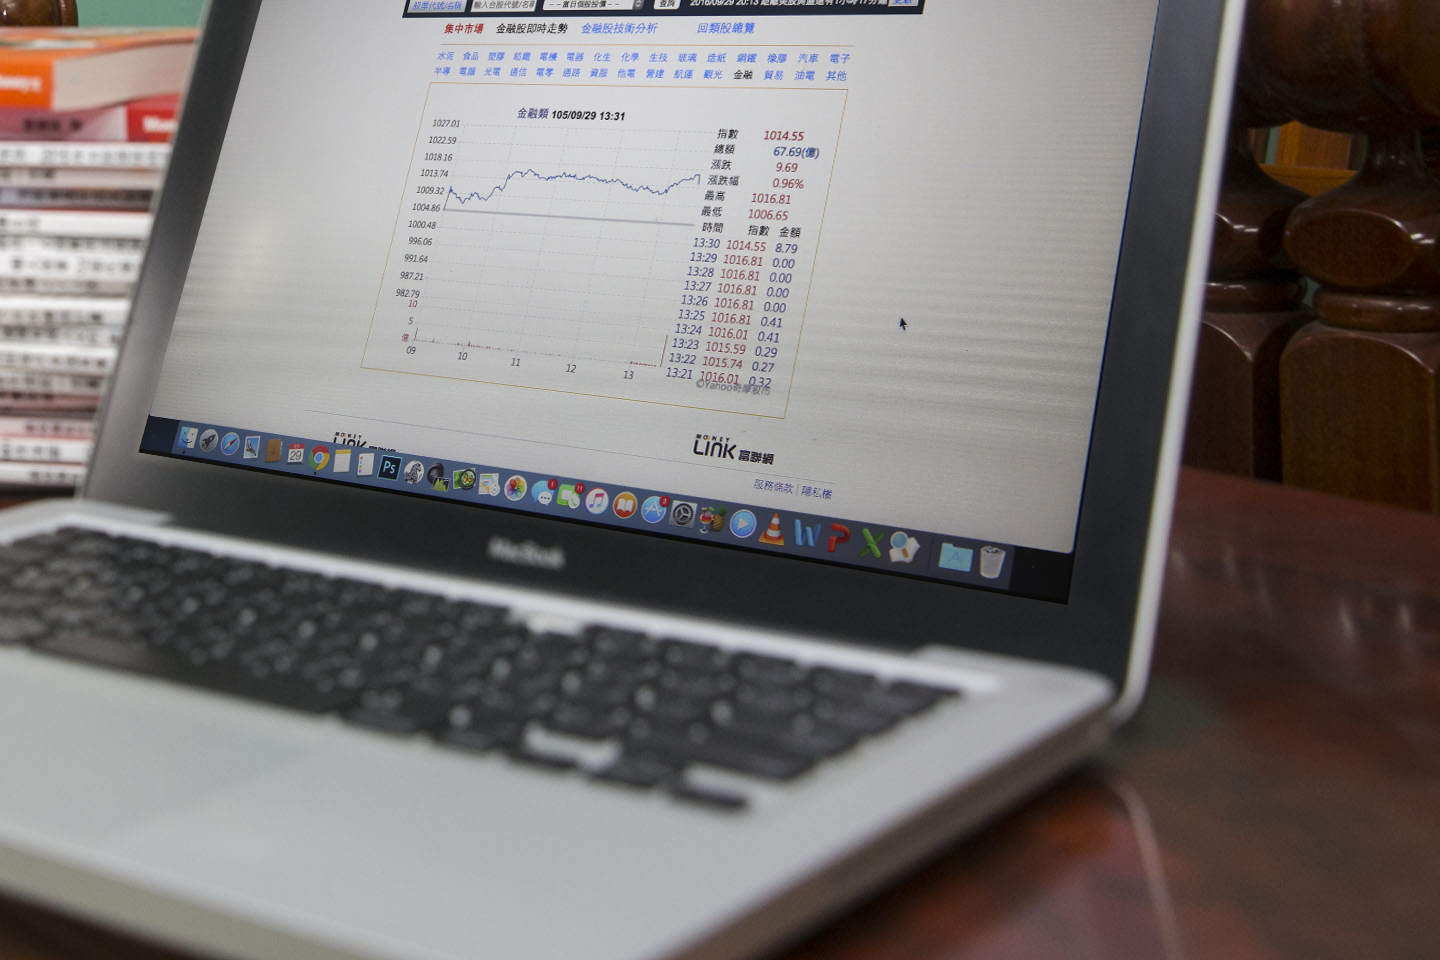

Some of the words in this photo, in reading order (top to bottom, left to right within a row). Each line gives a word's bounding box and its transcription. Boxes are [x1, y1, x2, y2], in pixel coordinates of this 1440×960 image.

[444, 23, 484, 35] 集中市場
[496, 23, 569, 35] 金融股即時走勢
[581, 22, 658, 35] 金融股技術分析
[697, 22, 756, 35] 回類股總覽
[463, 52, 479, 61] 食品
[593, 52, 611, 62] 化生
[649, 53, 668, 63] 生技
[797, 54, 819, 64] 汽車
[829, 54, 851, 64] 電子
[733, 70, 753, 80] 金融
[763, 70, 784, 81] 貿易
[825, 71, 847, 82] 其他
[517, 108, 549, 120] 金融類
[551, 110, 597, 121] 105/09/29
[599, 111, 626, 121] 13:31
[432, 119, 461, 128] 1027.01
[428, 136, 457, 145] 1022.59
[717, 128, 739, 140] 指數
[763, 130, 805, 141] 1014.55
[424, 153, 453, 162] 1018.16
[713, 144, 736, 155] 總額
[773, 146, 820, 159] 67.69(億)
[710, 159, 732, 170] 漲跌
[776, 162, 798, 173] 9.69
[420, 169, 449, 178] 1013.74
[707, 175, 740, 187] 漲跌幅
[772, 178, 804, 189] 0.96%
[416, 186, 445, 195] 1009.32
[704, 191, 726, 202] 最高
[751, 193, 791, 205] 1016.81
[412, 203, 441, 212] 1004.86
[701, 206, 723, 218] 最低
[748, 209, 789, 221] 1006.65
[408, 220, 436, 230] 1000.48
[702, 222, 724, 234] 時間
[748, 225, 770, 237] 指數
[779, 227, 802, 238] 金額
[408, 236, 433, 246] 996.06
[693, 237, 720, 249] 13:30
[726, 240, 767, 252] 1014.55
[775, 243, 798, 254] 8.79
[404, 254, 429, 264] 991.64
[690, 252, 718, 263] 13:29
[723, 254, 763, 267] 1016.81
[772, 257, 795, 269] 0.00
[400, 271, 424, 281] 987.21
[687, 266, 714, 278] 13:28
[720, 268, 760, 281] 1016.81
[769, 272, 792, 284] 0.00
[395, 288, 420, 299] 982.79
[684, 280, 712, 292] 13:27
[717, 283, 757, 296] 1016.81
[766, 287, 789, 299] 0.00
[408, 299, 418, 308] 10
[681, 295, 709, 307] 13:26
[714, 298, 754, 311] 1016.81
[763, 302, 786, 313] 0.00
[678, 309, 705, 321] 13:25
[711, 312, 751, 325] 1016.81
[760, 316, 782, 328] 0.41
[675, 323, 702, 335] 13:24
[708, 327, 748, 340] 1016.01
[757, 331, 779, 343] 0.41
[406, 346, 416, 355] 09
[672, 338, 699, 350] 13:23
[705, 341, 746, 355] 1015.59
[755, 346, 778, 358] 0.29
[457, 351, 468, 361] 10
[510, 357, 521, 367] 11
[566, 364, 577, 374] 12
[669, 353, 697, 365] 13:22
[702, 356, 743, 370] 1015.74
[752, 361, 775, 373] 0.27
[623, 370, 634, 380] 13
[666, 367, 693, 379] 13:21
[700, 371, 739, 385] 1016.01
[749, 376, 772, 389] 0.32
[290, 451, 302, 461] 29
[383, 461, 396, 474] Ps
